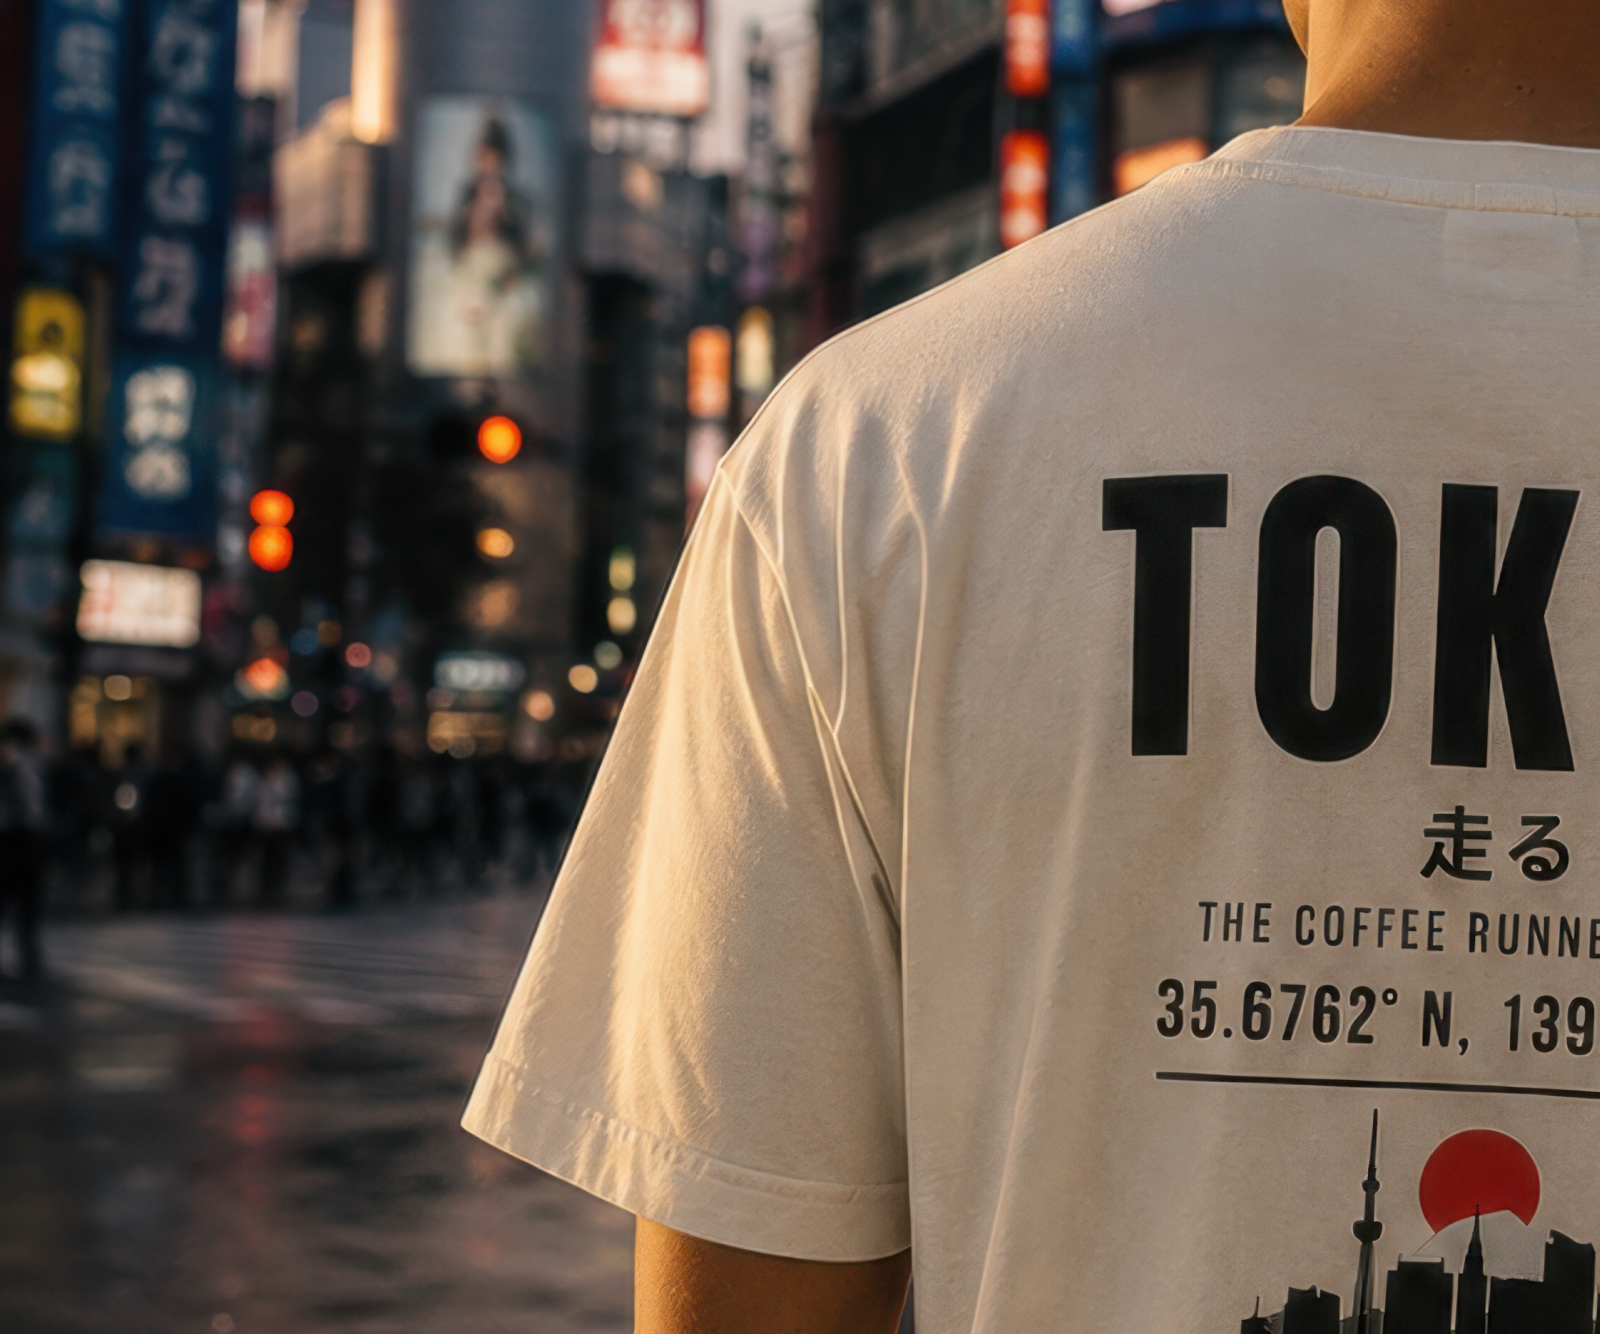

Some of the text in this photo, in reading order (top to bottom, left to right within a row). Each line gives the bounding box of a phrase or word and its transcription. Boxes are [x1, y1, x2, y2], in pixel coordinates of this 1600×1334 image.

[1419, 805, 1571, 882] 走る
[1199, 901, 1273, 943] THE
[1295, 904, 1446, 952] COFFEE
[1156, 978, 1399, 1044] 35.6762°
[1421, 990, 1470, 1056] N,
